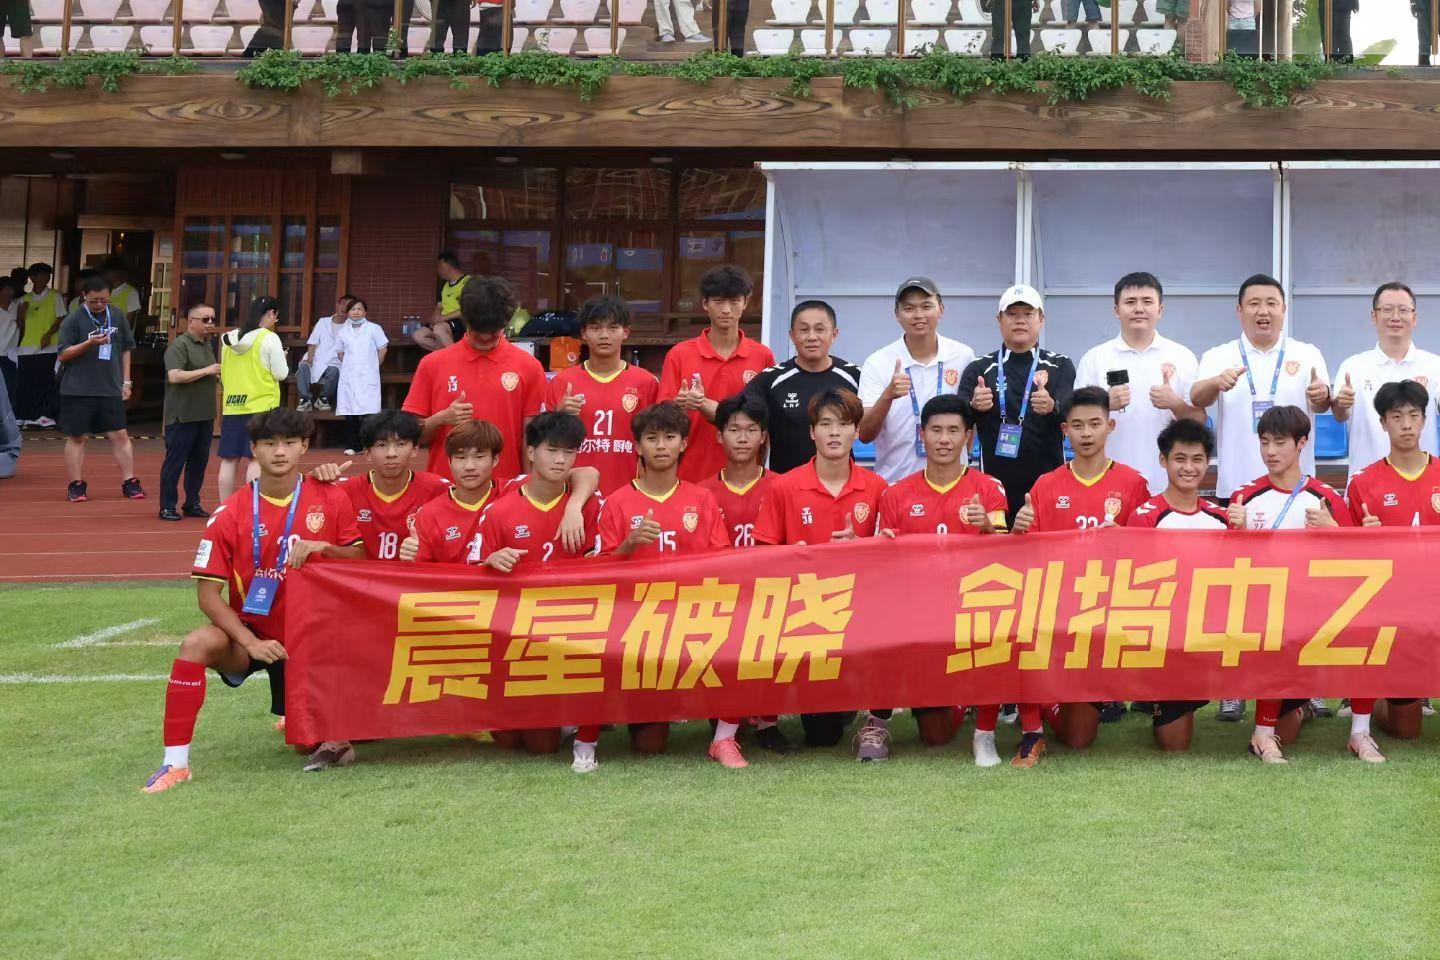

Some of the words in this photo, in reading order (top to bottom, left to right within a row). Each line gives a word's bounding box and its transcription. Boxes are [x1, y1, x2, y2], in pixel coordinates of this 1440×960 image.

[593, 410, 614, 436] 21
[378, 532, 398, 559] 18
[657, 531, 677, 552] 15
[384, 573, 856, 705] 晨星破晓
[946, 556, 1397, 674] 剑指中乙
